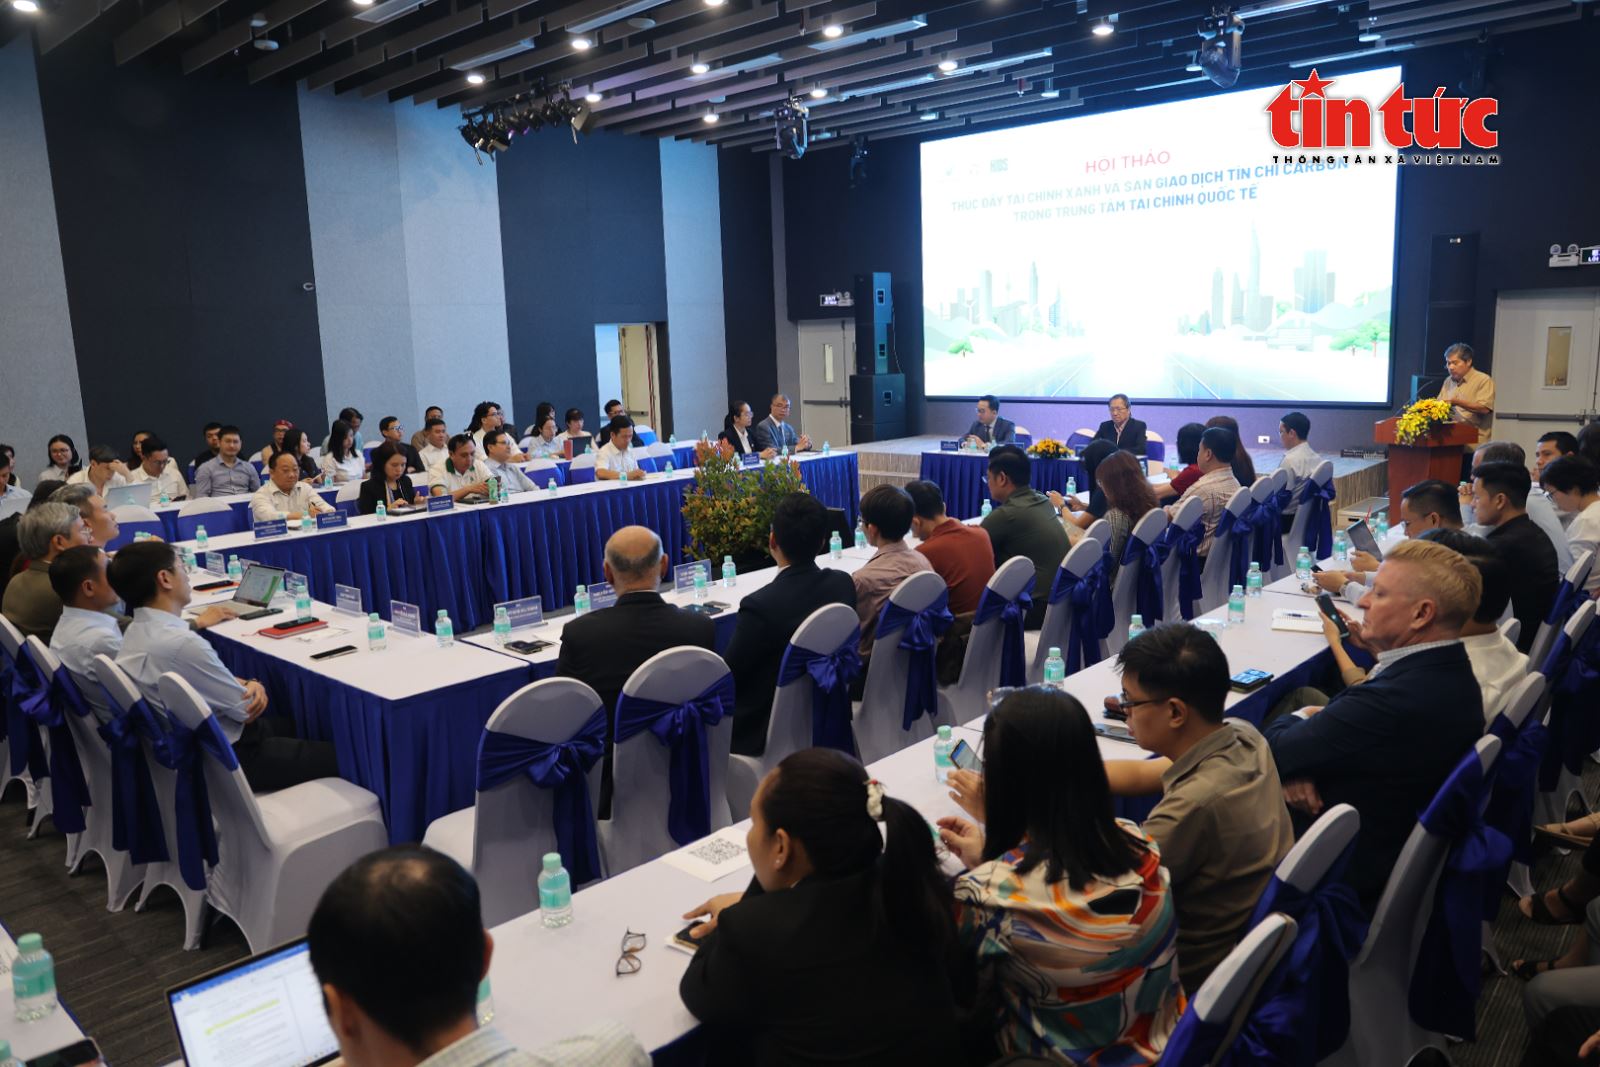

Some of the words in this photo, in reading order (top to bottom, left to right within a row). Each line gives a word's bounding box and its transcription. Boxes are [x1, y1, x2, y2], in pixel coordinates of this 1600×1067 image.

[1065, 184, 1101, 199] XANH
[1155, 173, 1188, 190] GIAO
[1013, 207, 1052, 222] TRONG
[1055, 203, 1096, 219] TRUNG
